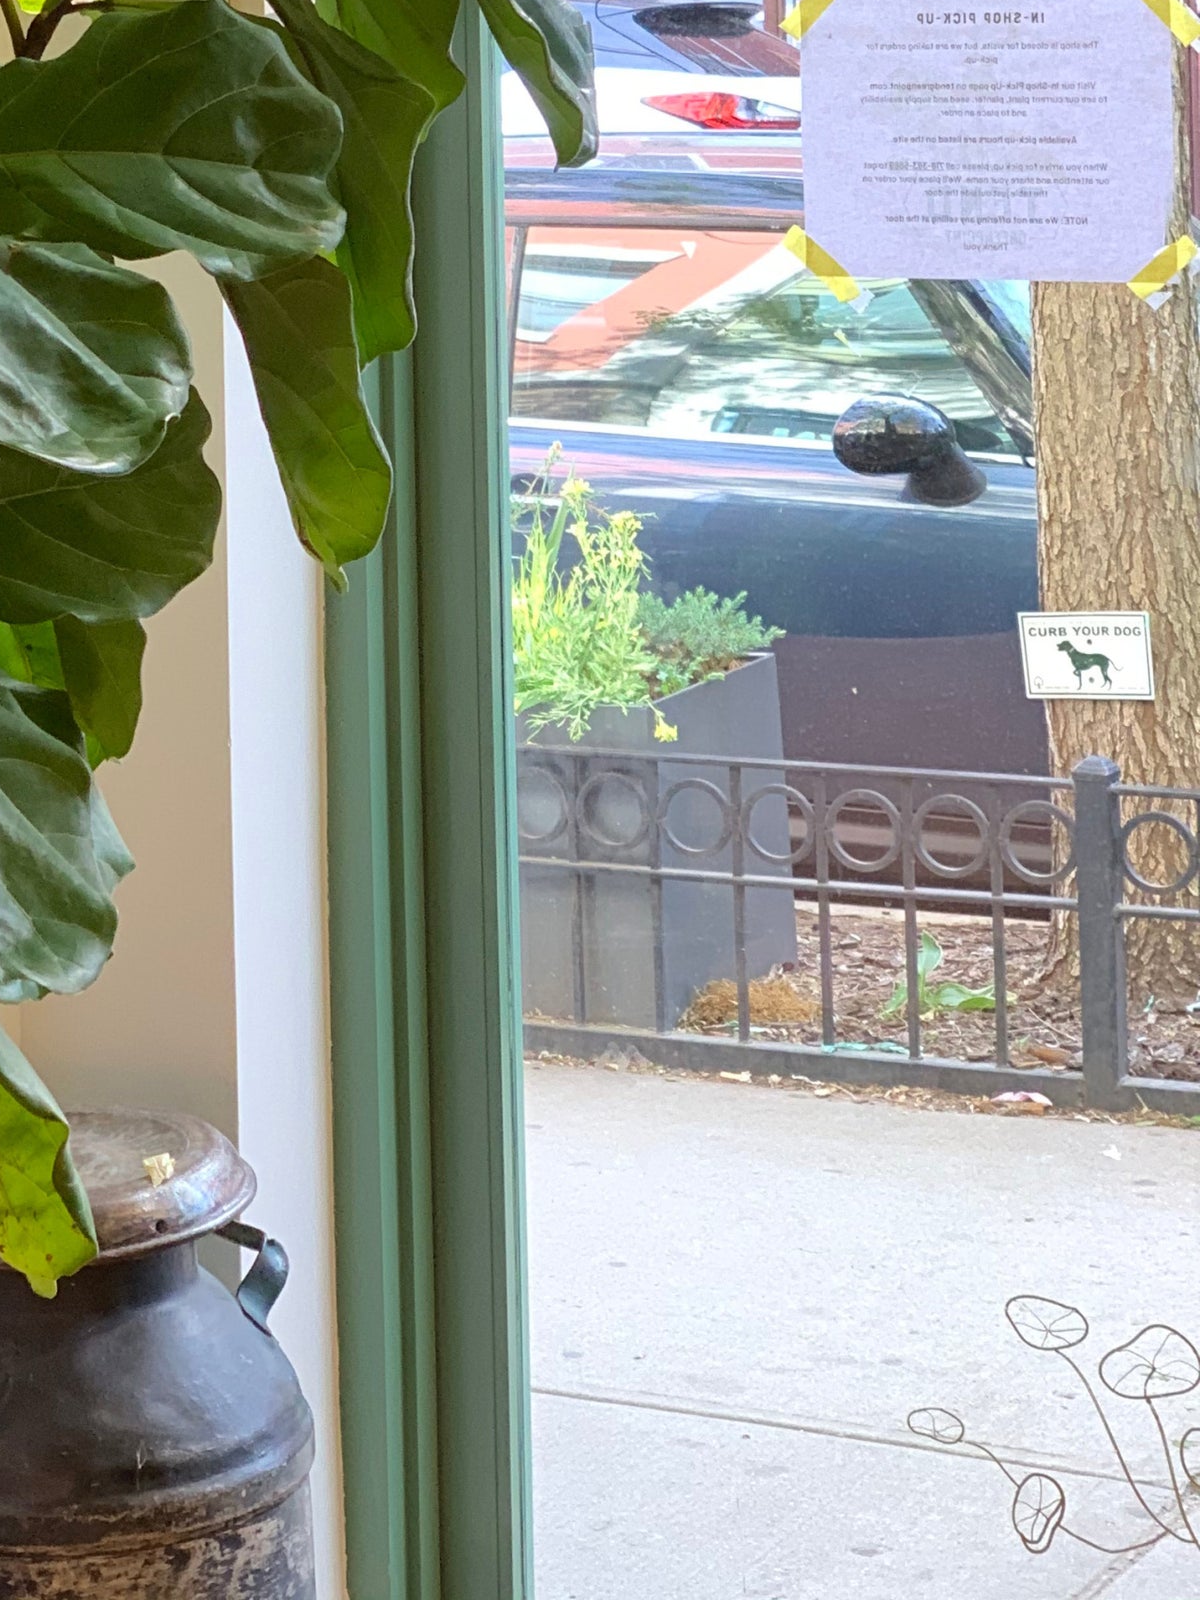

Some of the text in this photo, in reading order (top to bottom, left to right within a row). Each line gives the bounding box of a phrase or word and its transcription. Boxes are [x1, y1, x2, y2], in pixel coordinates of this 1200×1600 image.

[1028, 626, 1142, 637] CURB YOUR DOG
